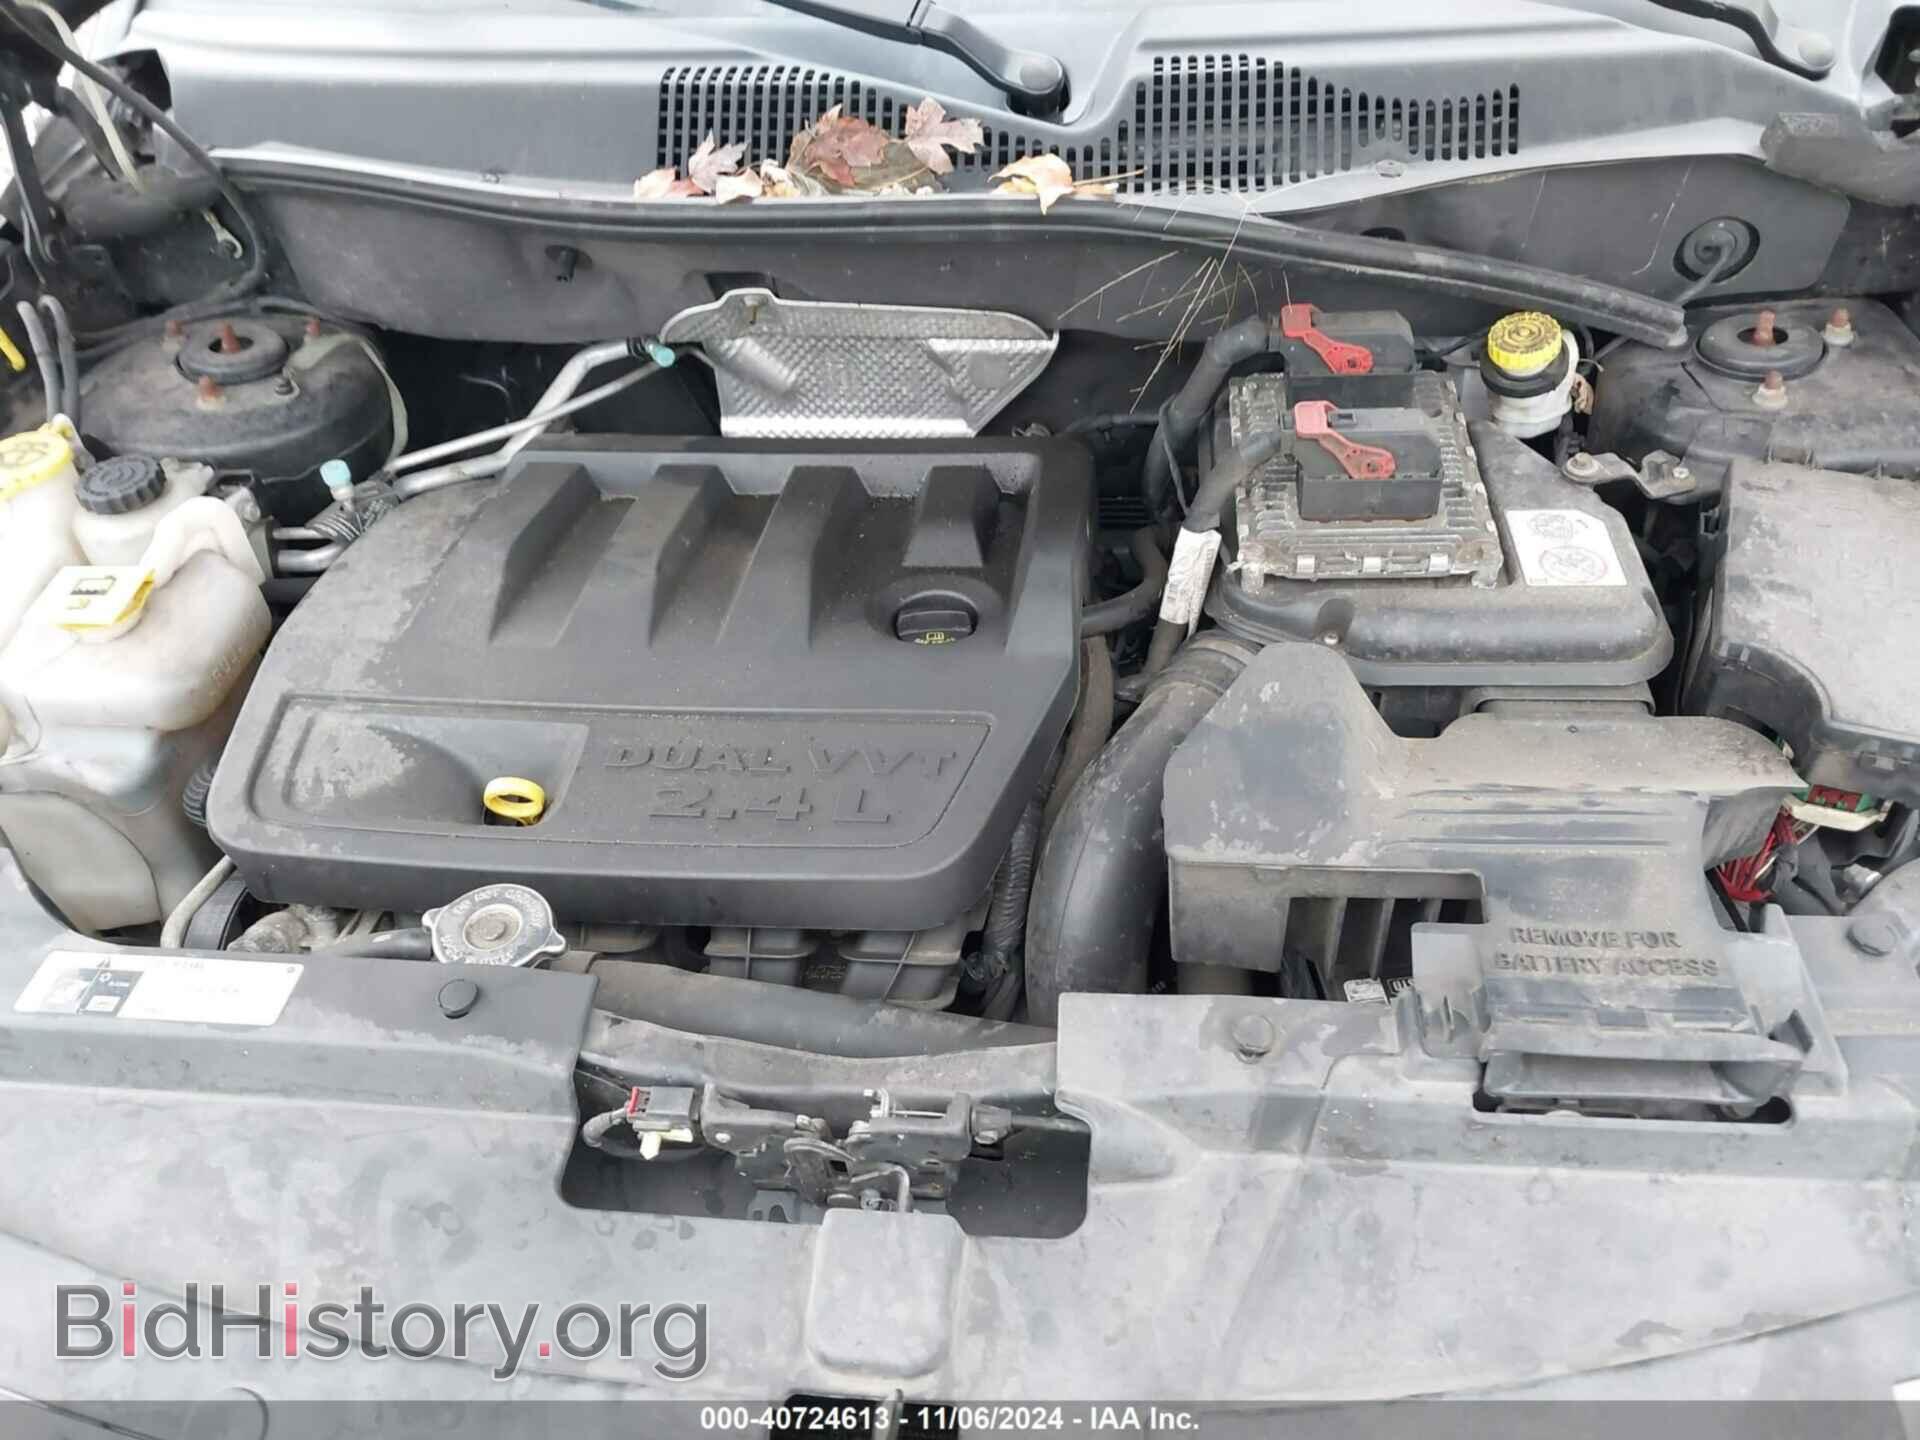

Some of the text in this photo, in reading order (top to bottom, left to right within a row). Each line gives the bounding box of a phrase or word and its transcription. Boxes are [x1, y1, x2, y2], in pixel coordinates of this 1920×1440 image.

[604, 743, 957, 777] DUAL VVT
[648, 784, 892, 824] 2.4 L
[1509, 926, 1684, 949] REMOVE FOR
[1495, 952, 1720, 977] BATTERY ACCESS
